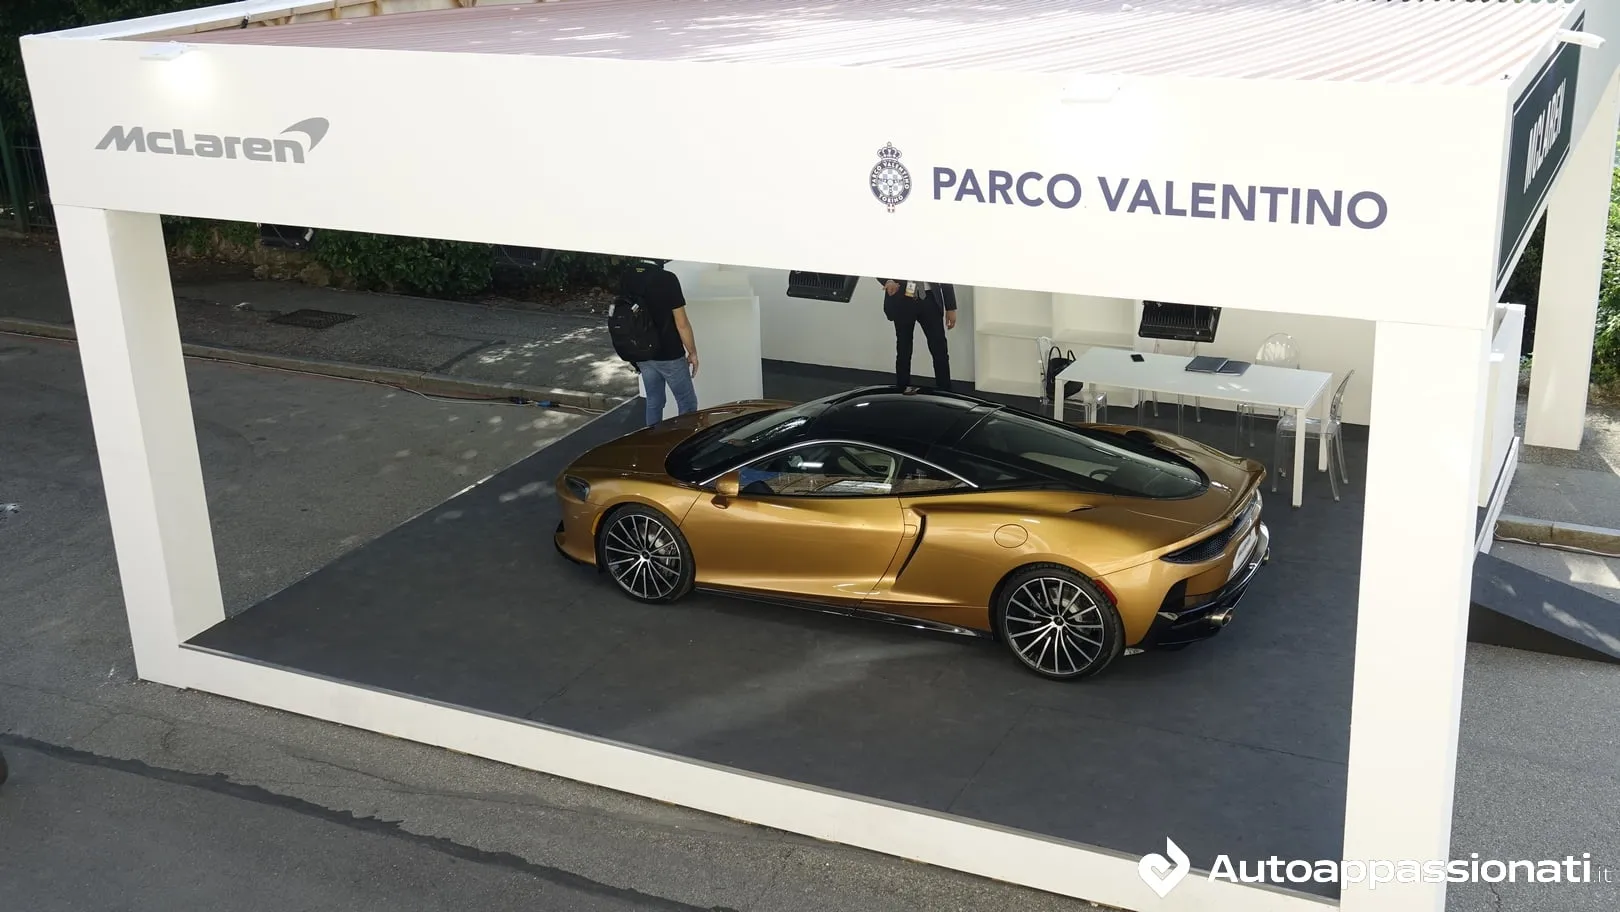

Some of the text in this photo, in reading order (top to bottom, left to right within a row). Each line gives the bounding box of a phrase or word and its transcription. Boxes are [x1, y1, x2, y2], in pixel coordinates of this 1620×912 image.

[95, 126, 304, 164] McLaren
[933, 166, 1388, 230] PARCO VALENTINO
